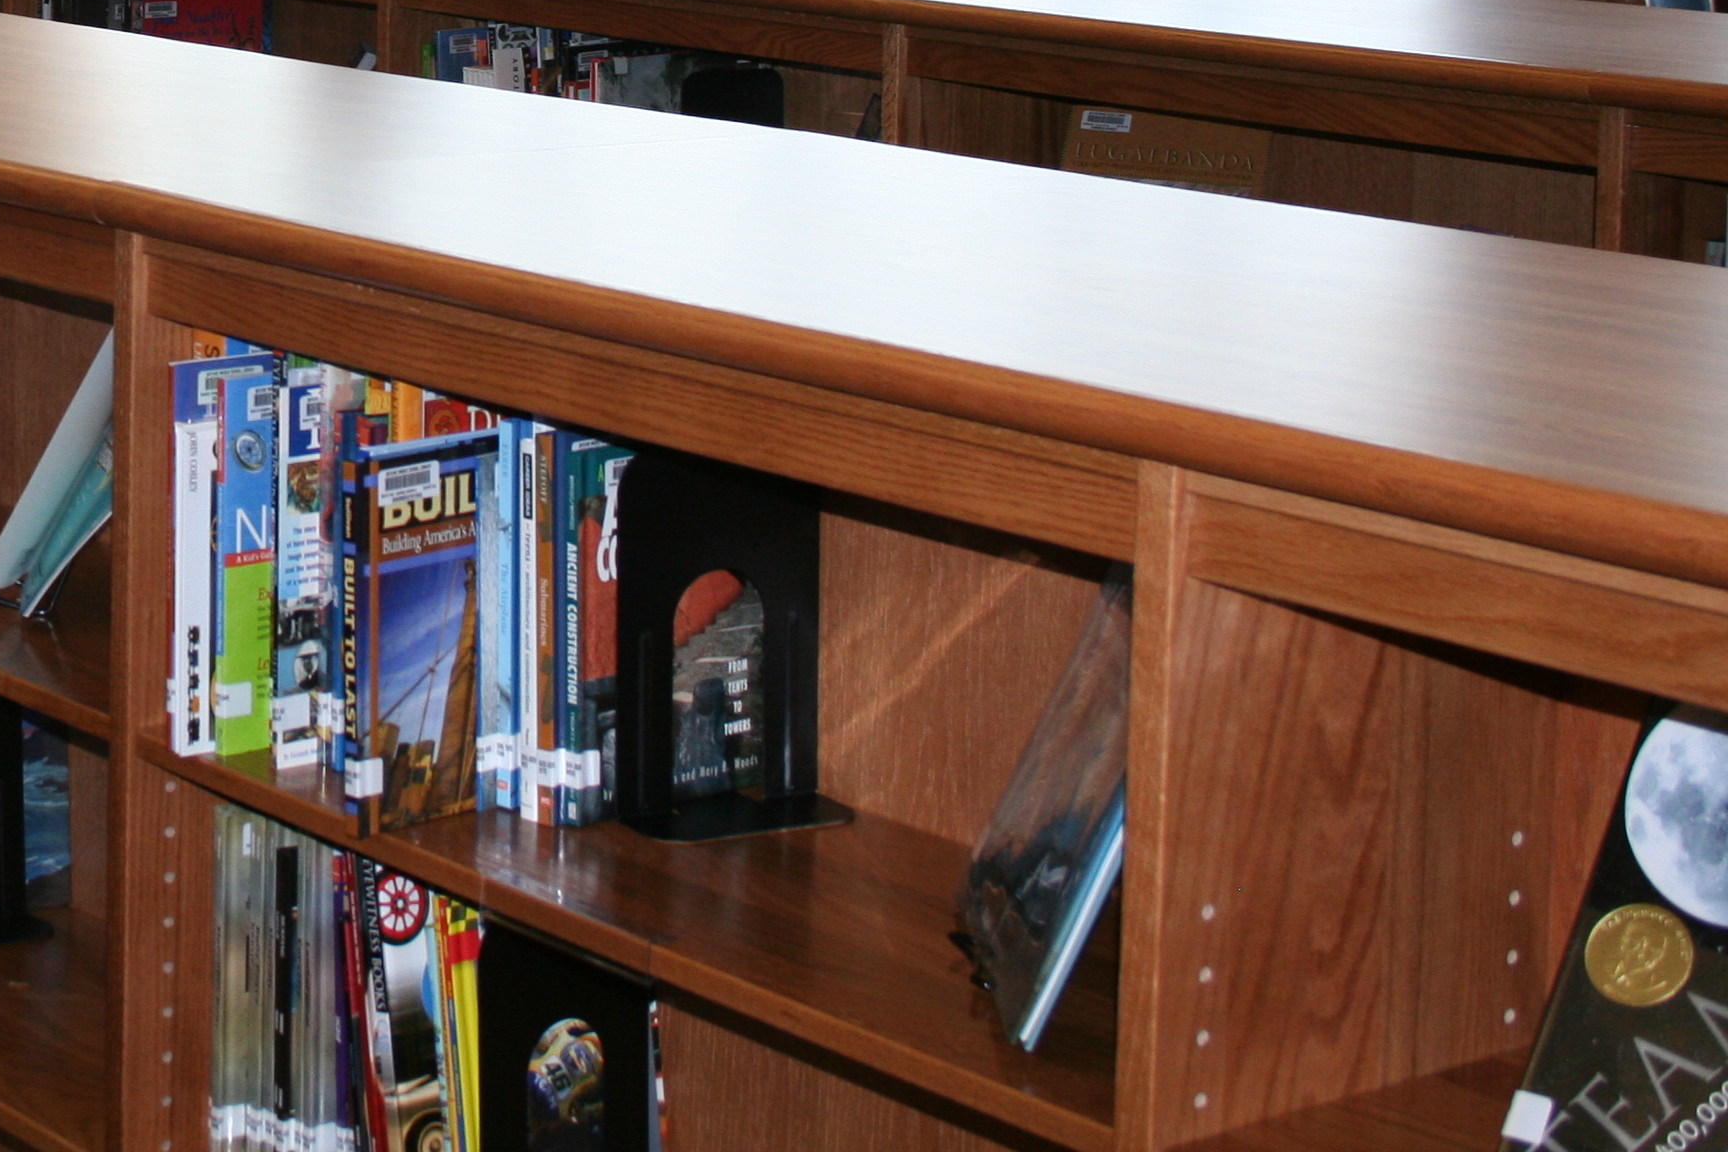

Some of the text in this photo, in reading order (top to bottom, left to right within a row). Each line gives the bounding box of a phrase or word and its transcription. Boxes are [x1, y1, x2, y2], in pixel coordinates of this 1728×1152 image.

[1075, 142, 1254, 171] LUGALBANDA
[382, 532, 422, 555] Building
[423, 524, 467, 547] America's
[567, 542, 578, 600] ANCIENT
[344, 557, 356, 631] BUILT
[539, 578, 548, 647] Submarines
[345, 635, 356, 670] TO
[566, 604, 578, 705] CONSTRUCTION
[728, 658, 748, 674] FROM
[728, 678, 748, 695] TENTS
[345, 673, 357, 740] LAST
[733, 700, 742, 714] TO
[724, 718, 751, 736] TOWERS
[699, 765, 718, 778] Mary
[734, 753, 758, 769] Woods
[362, 858, 387, 1011] EYEWITNESS BOOKS
